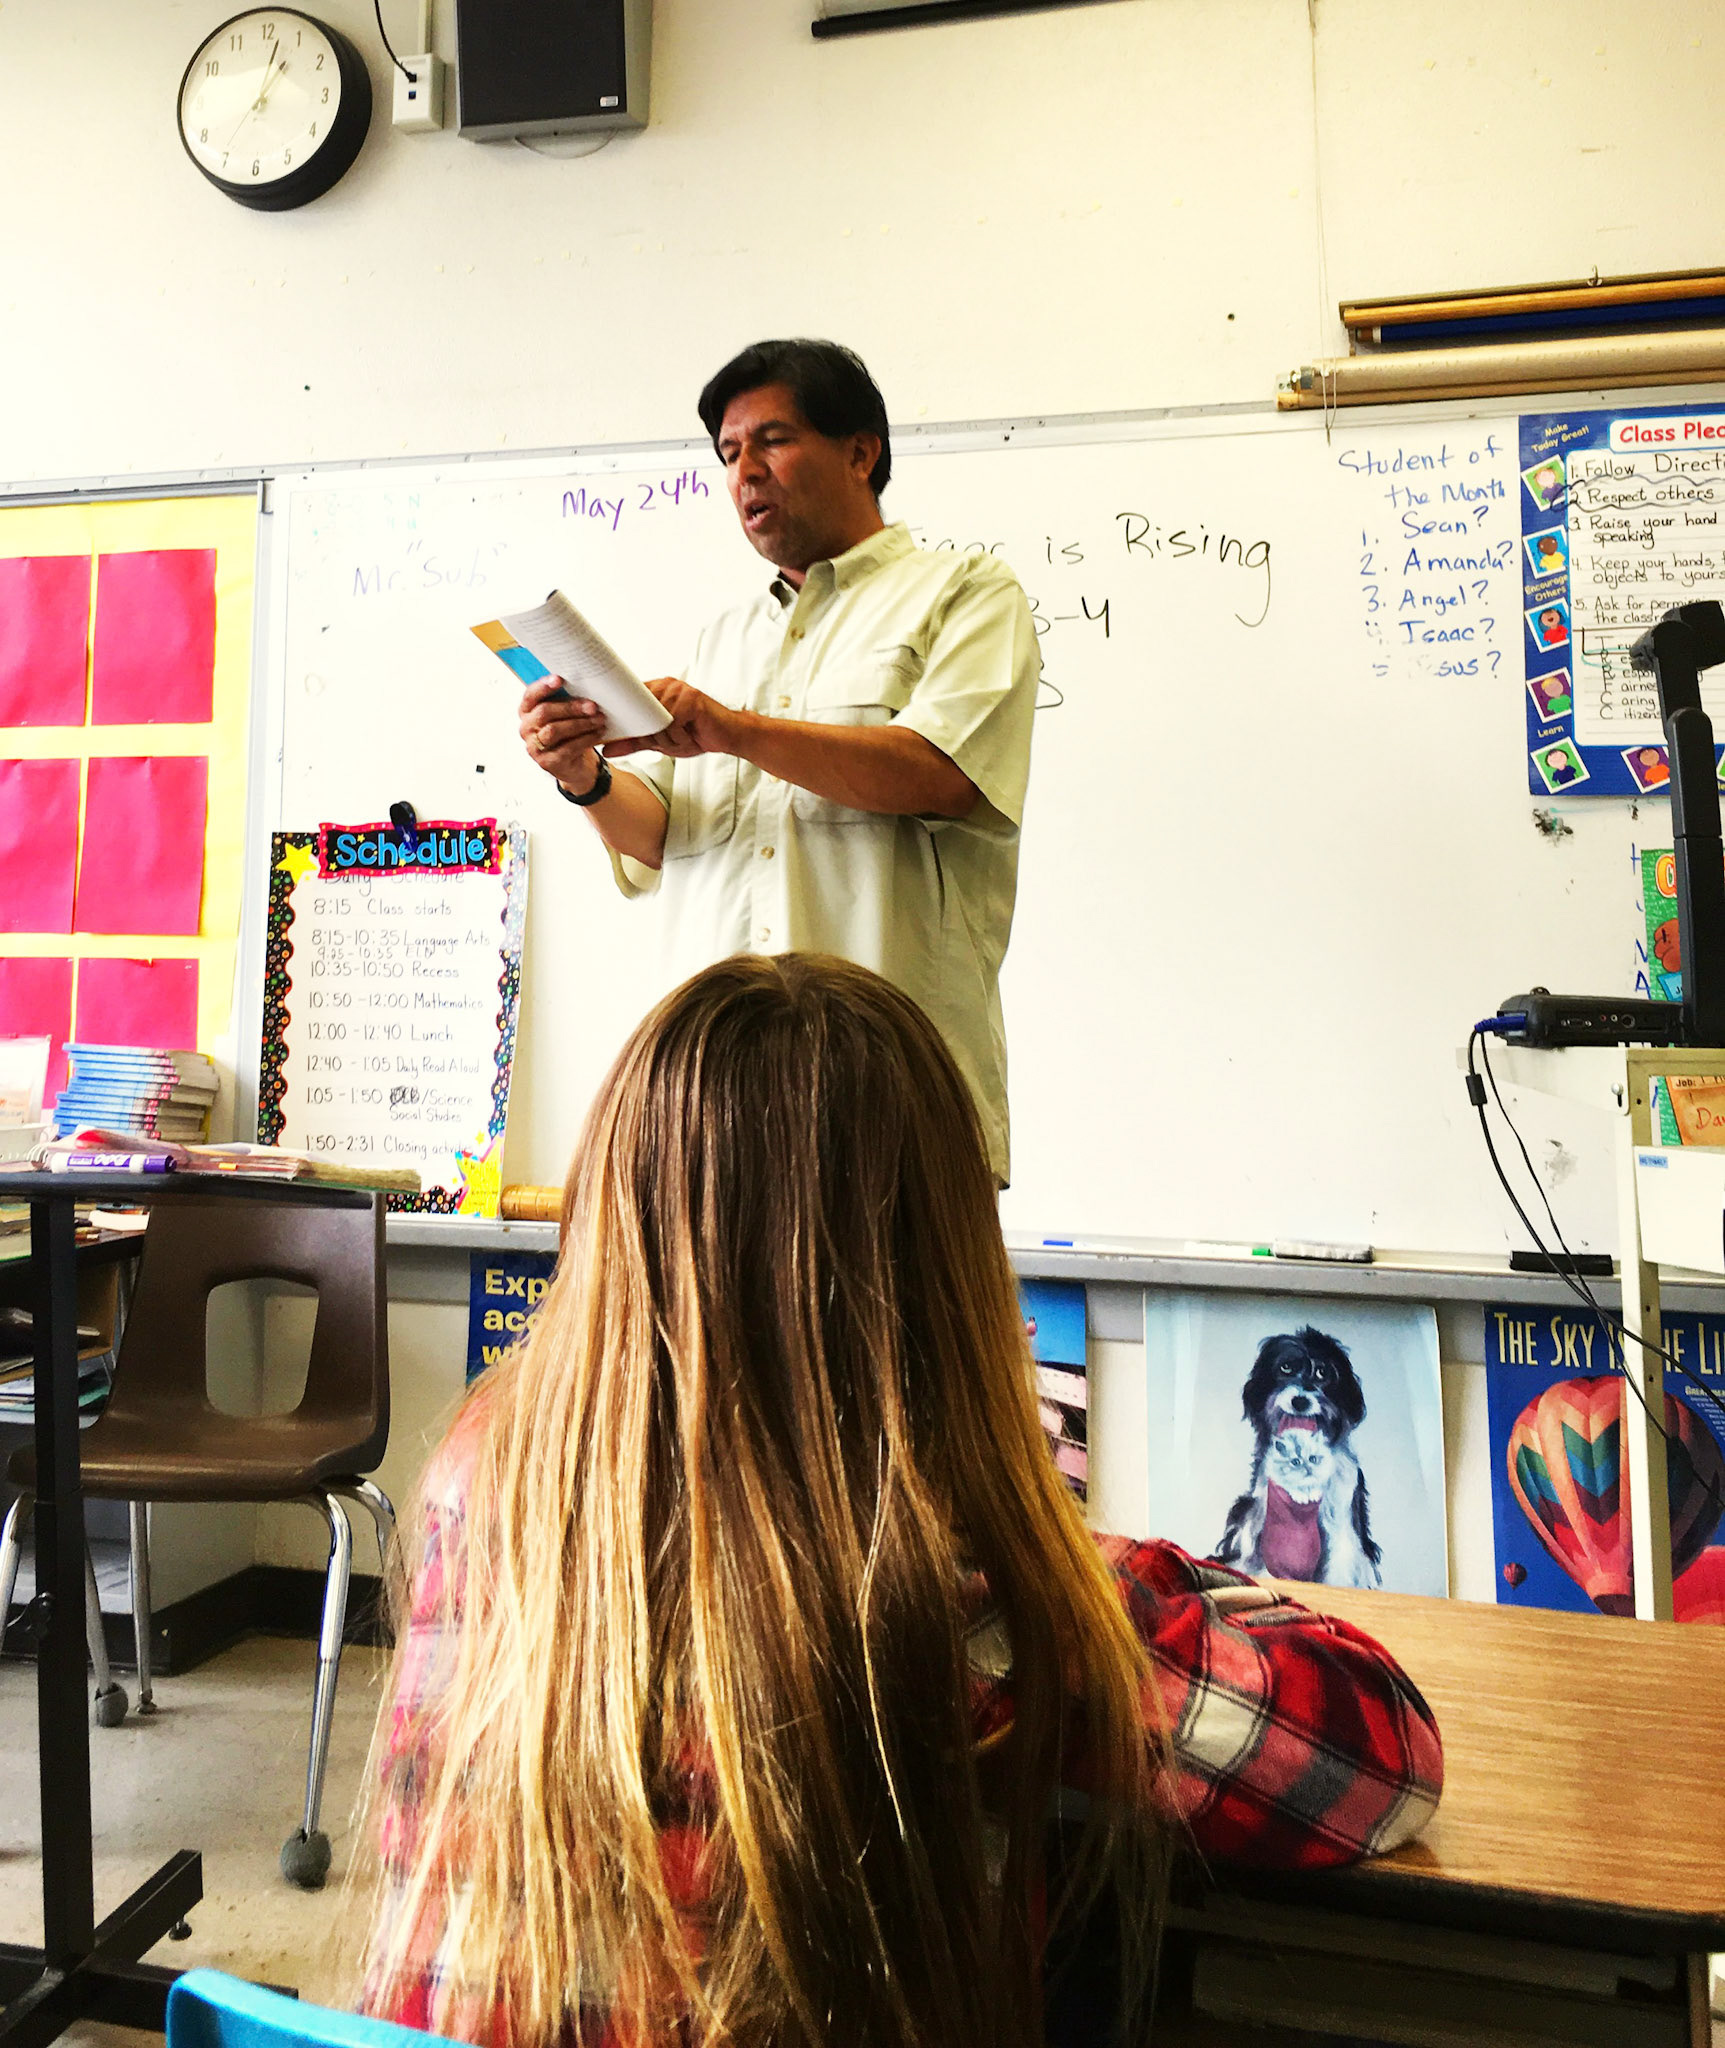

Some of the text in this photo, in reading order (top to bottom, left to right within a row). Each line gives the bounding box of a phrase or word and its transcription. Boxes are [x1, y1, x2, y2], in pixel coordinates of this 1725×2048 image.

[262, 23, 275, 40] 12
[296, 31, 301, 47] 1
[230, 35, 243, 52] 11
[206, 61, 219, 77] 10
[316, 53, 324, 71] 2
[321, 87, 329, 104] 3
[200, 128, 208, 144] 8
[309, 122, 317, 138] 4
[222, 152, 229, 168] 7
[284, 149, 291, 165] 5
[252, 160, 260, 176] 6
[1531, 425, 1590, 453] Today Great!
[1544, 423, 1569, 437] Make
[1619, 426, 1676, 443] Class
[1338, 435, 1503, 476] Student of
[1585, 459, 1636, 478] Follow
[562, 470, 710, 531] May 24th
[1384, 478, 1506, 509] the Month
[1588, 488, 1647, 508] Respect
[1656, 485, 1715, 500] others
[1401, 505, 1489, 539] Sean?
[1590, 515, 1632, 530] Raise
[1643, 518, 1676, 534] your
[1685, 512, 1718, 527] hand
[1593, 531, 1655, 550] speaking
[1360, 541, 1515, 576] 2. Amanda?
[1591, 556, 1630, 574] Keep
[1636, 559, 1666, 576] your
[1673, 552, 1716, 569] hands,
[1046, 511, 1272, 628] is Rising
[1525, 574, 1568, 596] Encourage
[1593, 568, 1648, 590] objects
[1660, 570, 1675, 581] to
[1362, 580, 1489, 616] 3. Angel?
[1535, 585, 1567, 601] Others
[1574, 599, 1588, 610] 5.
[1595, 596, 1619, 610] Ask
[1627, 595, 1646, 610] for
[1594, 610, 1664, 624] the classr
[1537, 726, 1565, 738] Learn
[336, 831, 486, 866] Schedule
[314, 898, 452, 916] 8:15 Class starts
[403, 929, 460, 955] Language
[464, 929, 491, 947] Arts
[412, 960, 460, 978] Recess
[413, 992, 484, 1009] Mathematics
[308, 1023, 347, 1041] 12:00
[364, 1023, 402, 1041] 12:40
[411, 1024, 453, 1042] Lunch
[307, 1055, 342, 1072] 12:40
[363, 1056, 391, 1072] 1:05
[396, 1057, 418, 1079] Daily
[422, 1057, 446, 1073] Read
[1676, 1077, 1697, 1088] Job:
[307, 1087, 333, 1104] 1:05
[351, 1087, 383, 1105] 1:50
[390, 1107, 461, 1122] Social Studies
[383, 1135, 427, 1159] Closing
[1494, 1312, 1539, 1366] THE
[1550, 1315, 1596, 1369] SKY
[1698, 1322, 1725, 1376] LI
